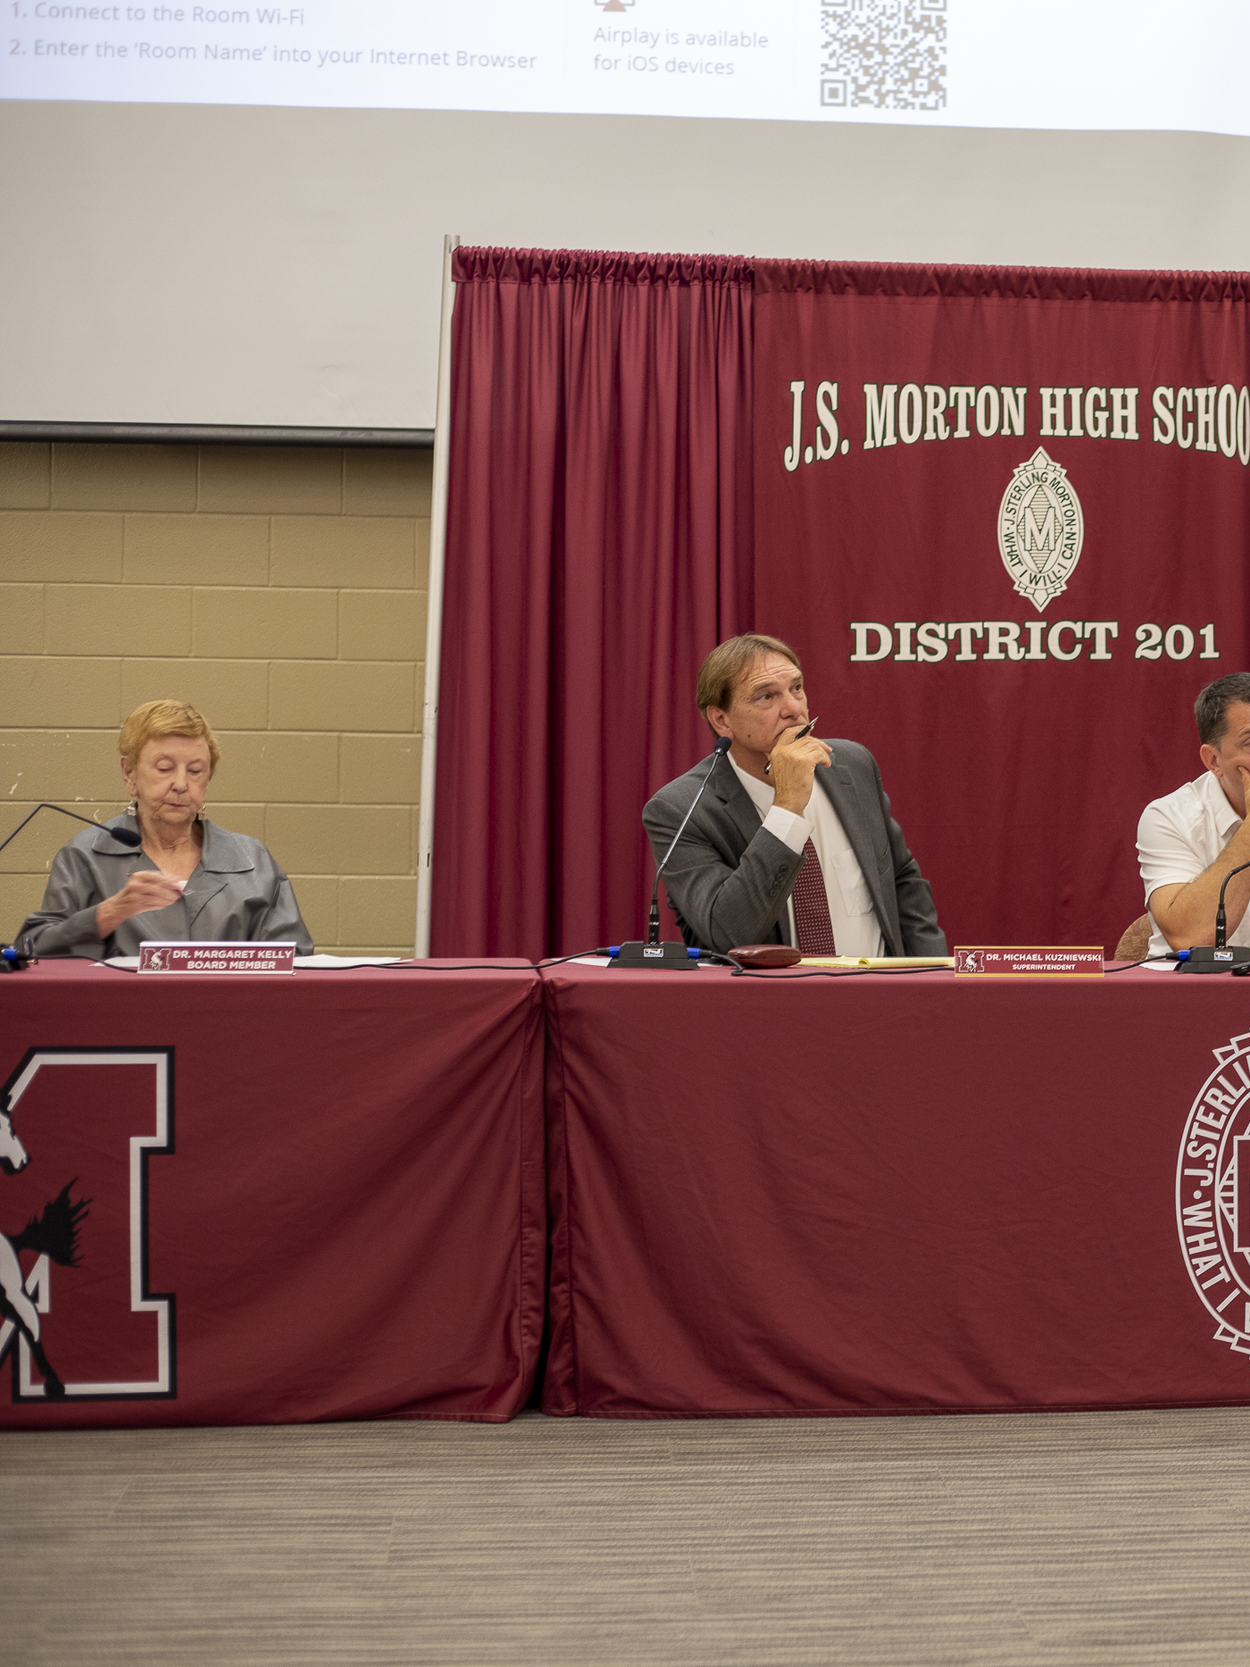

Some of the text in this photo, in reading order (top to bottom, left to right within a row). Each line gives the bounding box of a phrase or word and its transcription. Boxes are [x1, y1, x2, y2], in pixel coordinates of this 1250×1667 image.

[11, 2, 304, 25] 1. Connect to the Room Wi-Fi
[594, 27, 769, 48] Airplay is available
[9, 39, 26, 56] 2.
[34, 40, 89, 57] Enter
[96, 41, 128, 58] the
[274, 45, 312, 63] into
[318, 50, 364, 68] your
[370, 48, 450, 67] Internet
[456, 50, 538, 69] Browser
[594, 54, 735, 75] for iOS devices
[783, 379, 850, 473] J.S.
[862, 382, 1028, 450] MORTON
[1039, 385, 1140, 441] HIGH
[1049, 477, 1076, 526] MORTON
[1004, 531, 1023, 568] WHAT
[1062, 532, 1077, 561] CAN
[850, 621, 1220, 663] DISTRICT 201
[172, 950, 293, 959] DR. MARGARET KELLY
[187, 961, 276, 970] BOARD MEMBER
[1045, 954, 1101, 962] KUZNIEWSKI
[1183, 1200, 1230, 1290] WHAT
[1216, 1288, 1240, 1313] I
